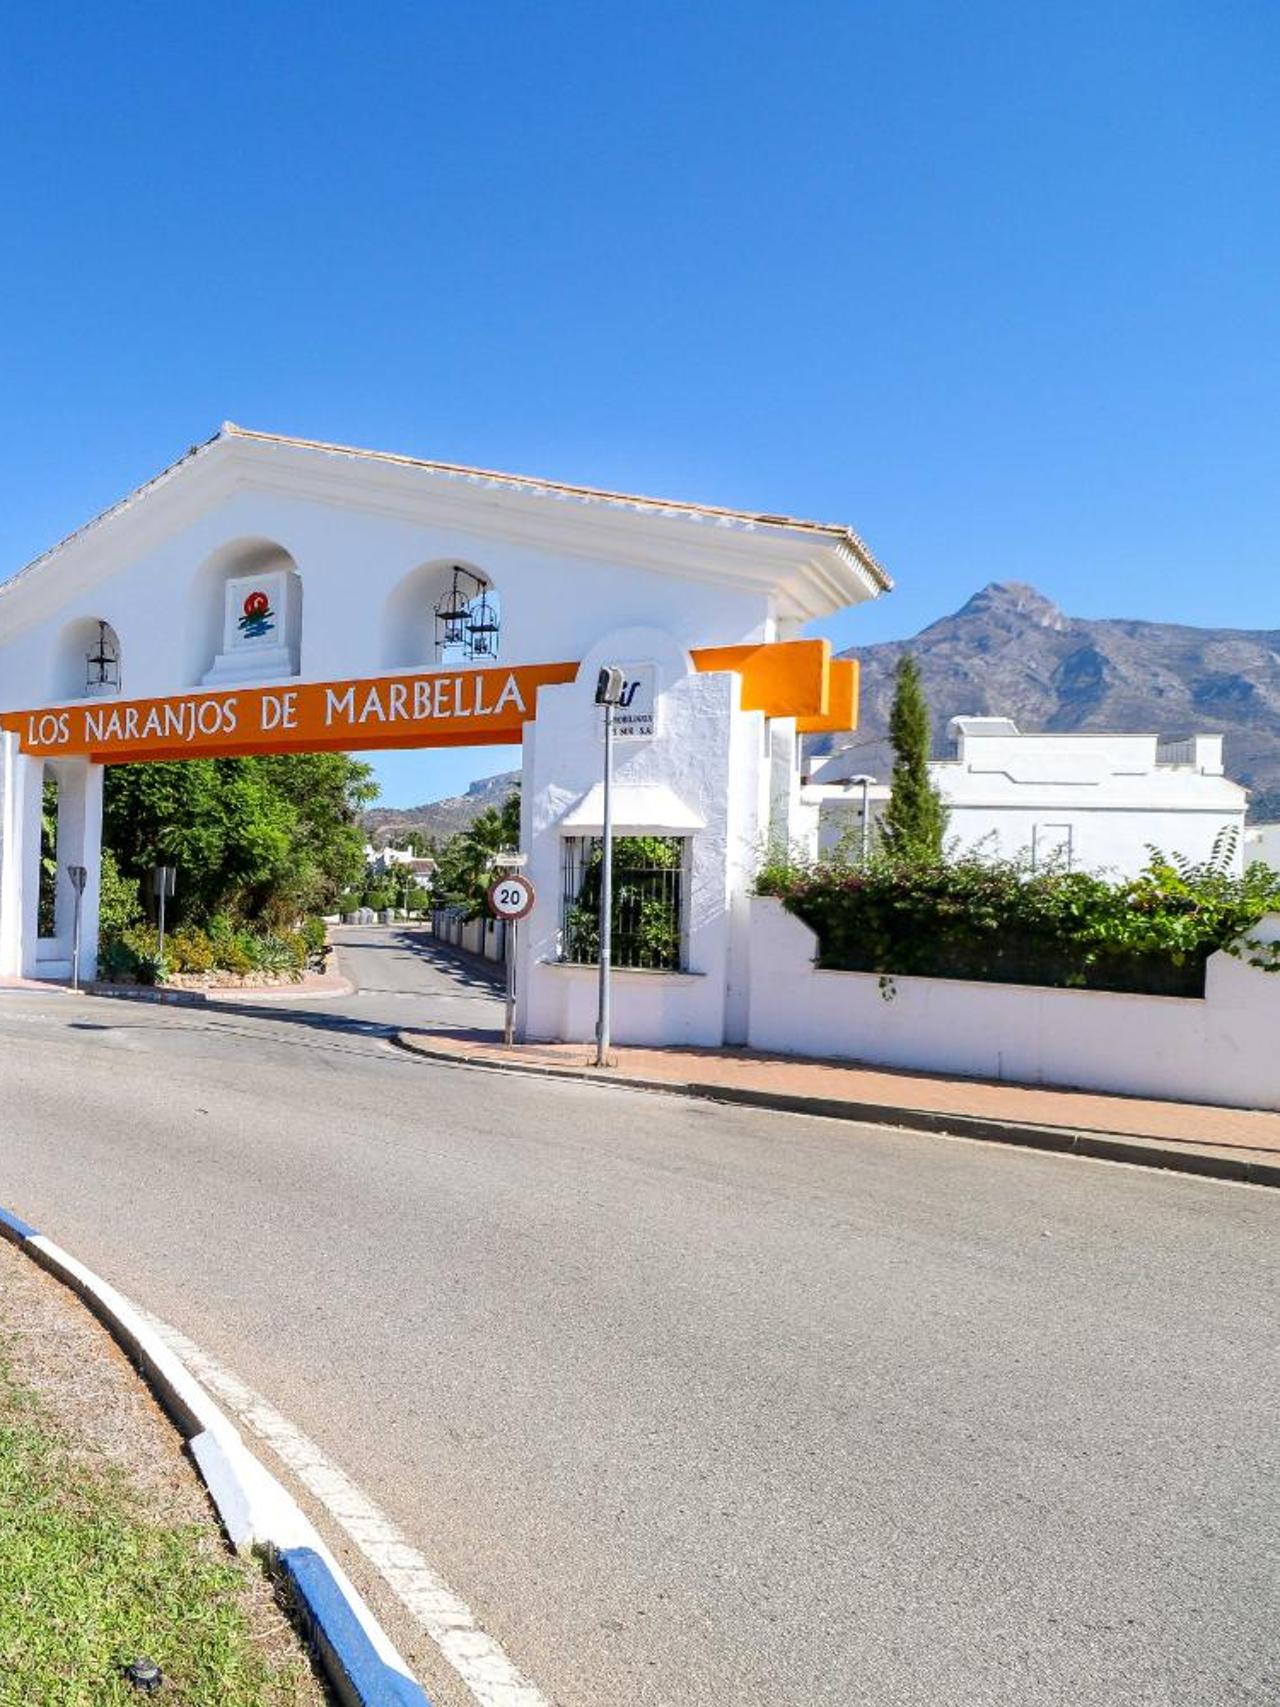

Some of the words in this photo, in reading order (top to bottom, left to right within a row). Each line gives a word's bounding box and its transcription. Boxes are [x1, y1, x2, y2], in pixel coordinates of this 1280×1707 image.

[28, 712, 70, 745] LOS
[84, 697, 237, 743] NARANJOS
[261, 692, 298, 731] DE
[324, 673, 527, 726] MARBELLA
[500, 888, 520, 906] 20
